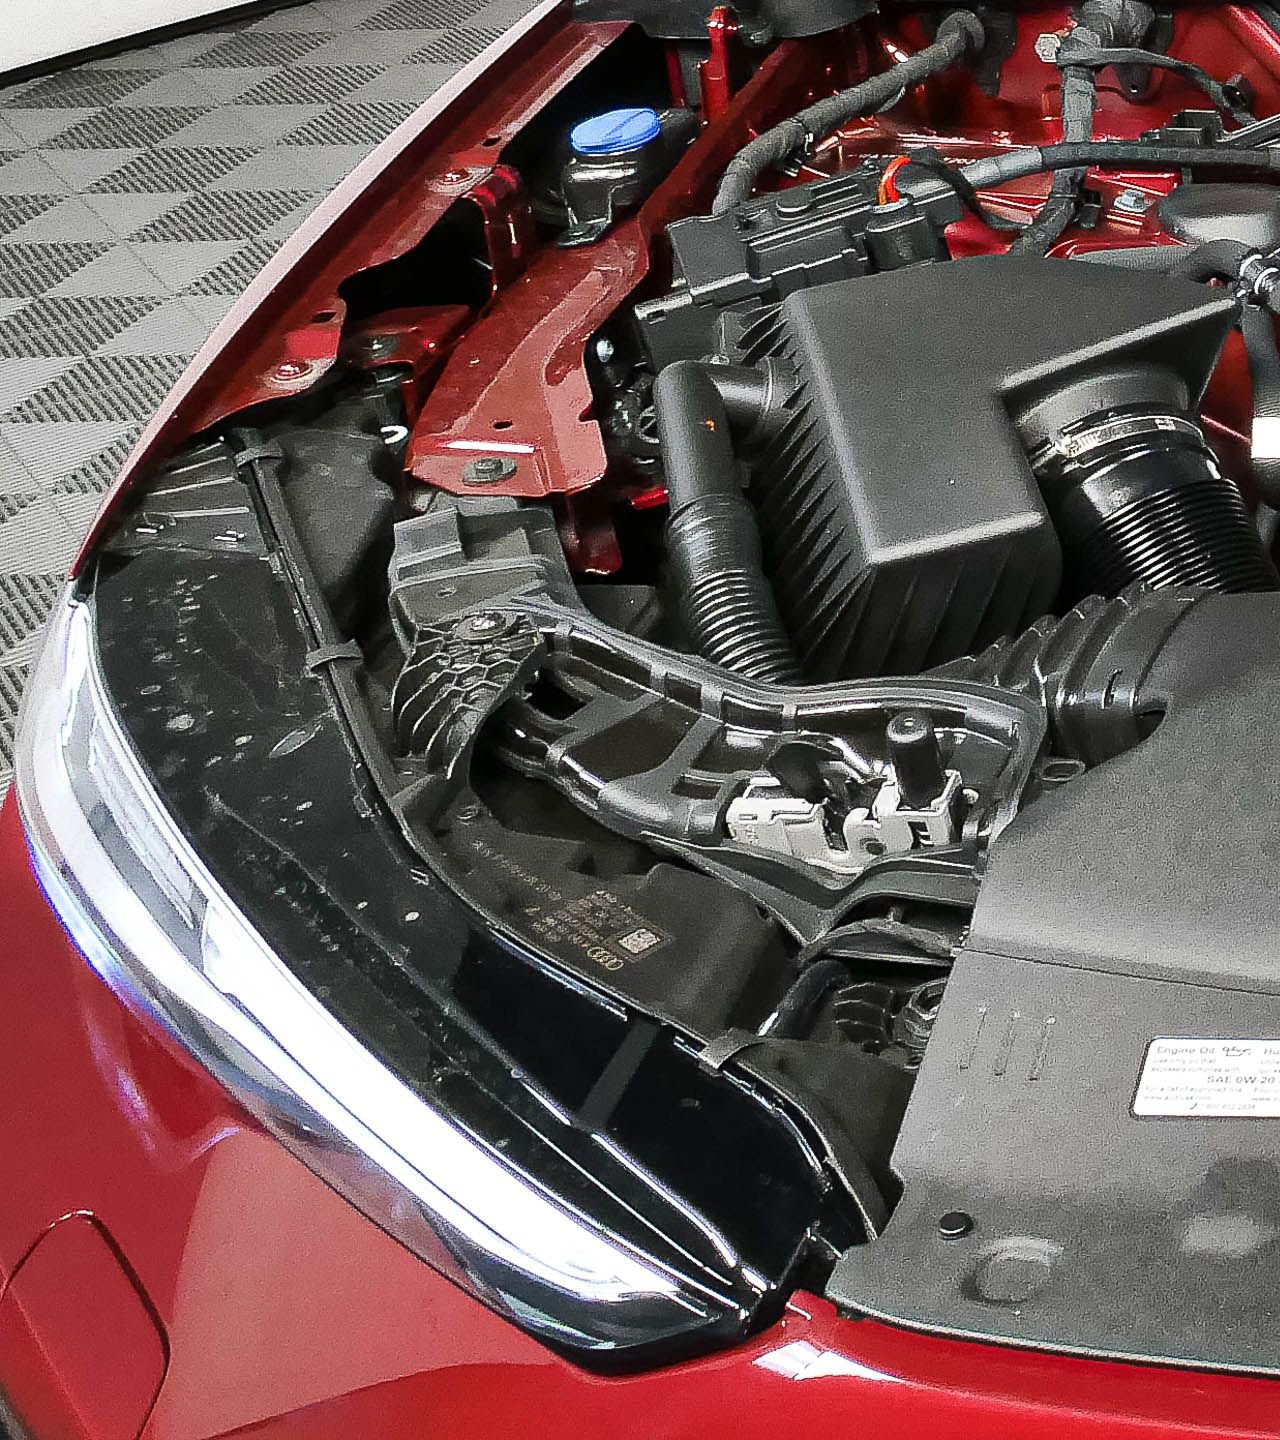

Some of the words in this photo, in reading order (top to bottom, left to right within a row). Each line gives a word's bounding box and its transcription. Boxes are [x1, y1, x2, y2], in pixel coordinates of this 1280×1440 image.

[1156, 1046, 1196, 1055] Engine
[1199, 1046, 1216, 1054] Oil
[1207, 1075, 1232, 1084] SAE
